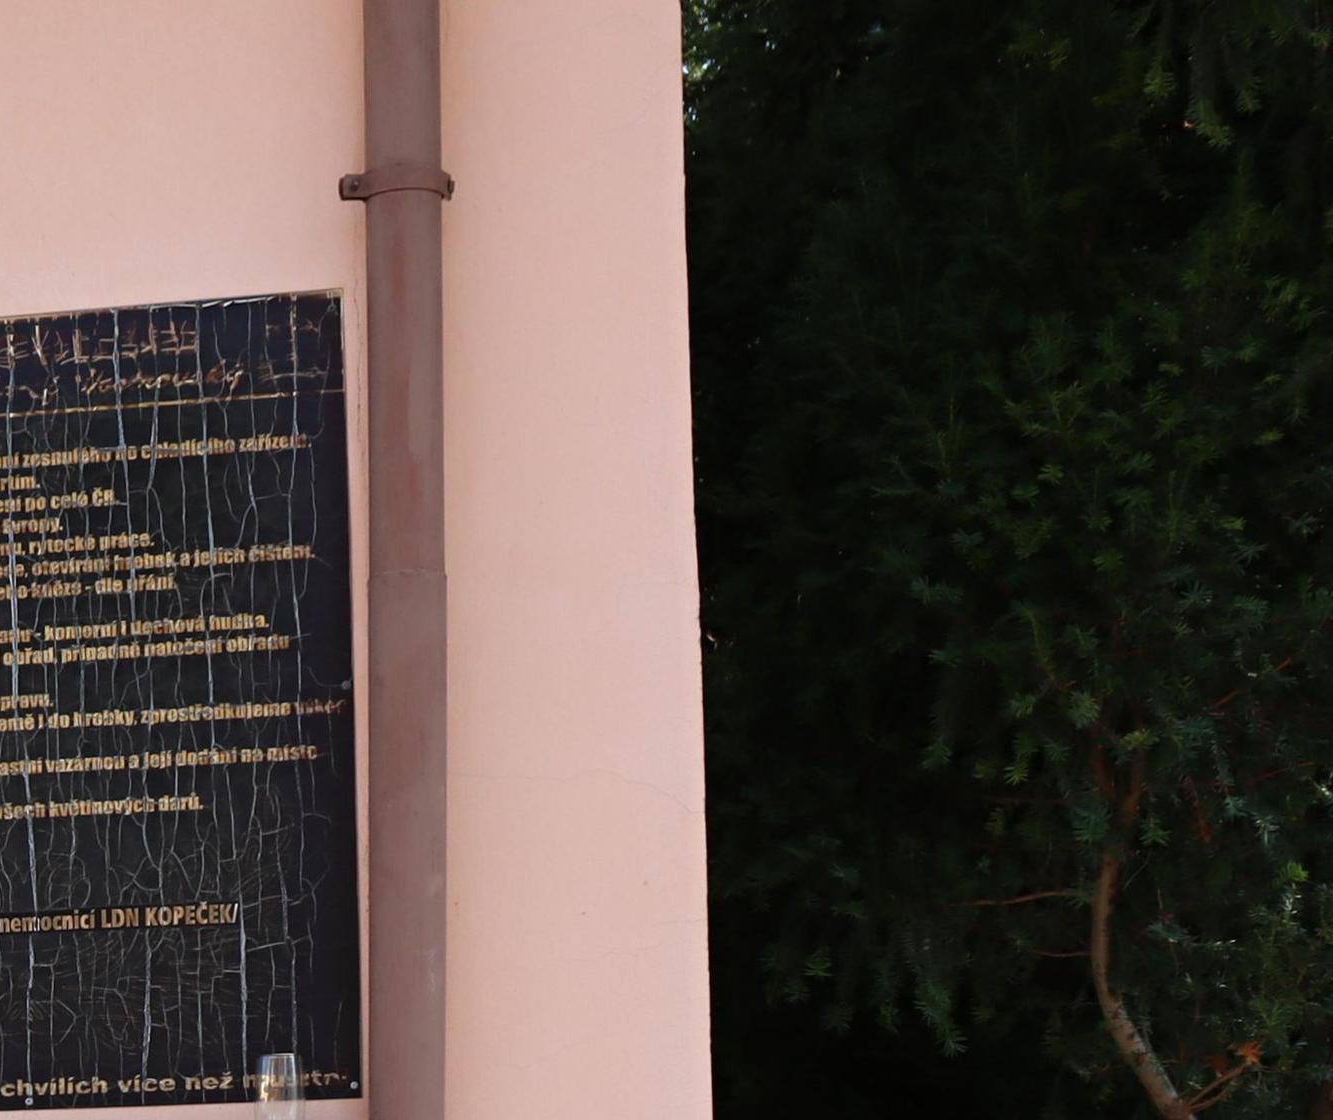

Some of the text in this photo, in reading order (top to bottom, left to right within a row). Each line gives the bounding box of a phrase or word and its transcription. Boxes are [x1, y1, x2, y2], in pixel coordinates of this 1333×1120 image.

[129, 754, 139, 769] a
[0, 908, 95, 933] nemocnicí
[101, 906, 139, 928] LDN
[145, 901, 238, 926] KOPEČEK/
[0, 1074, 109, 1098] chvílích
[118, 1074, 175, 1094] více
[185, 1071, 234, 1092] než
